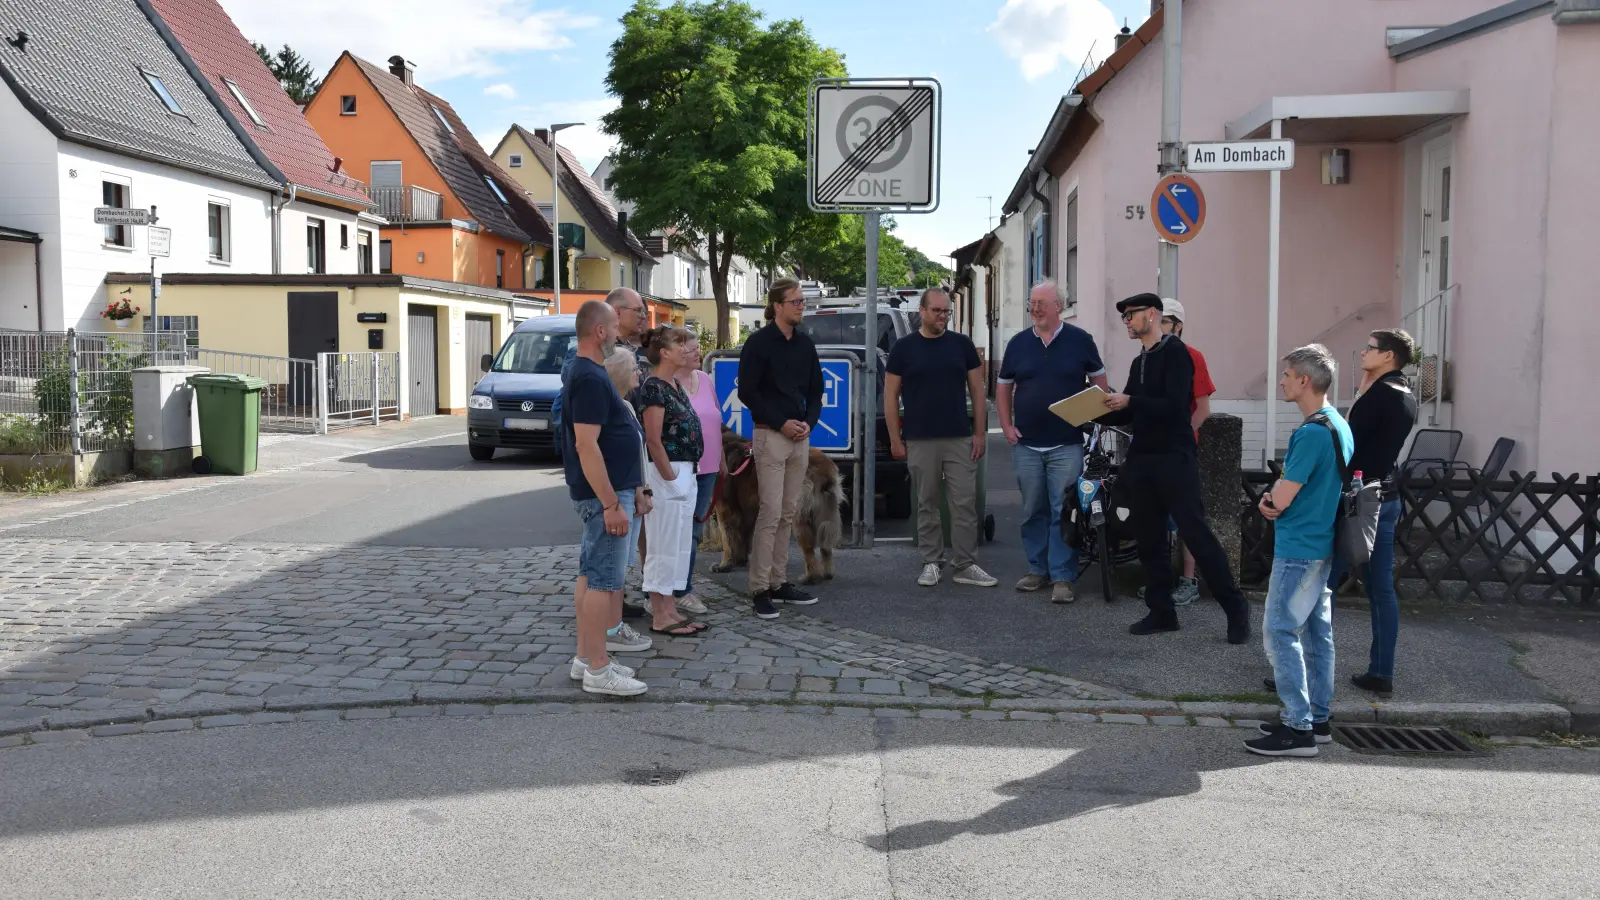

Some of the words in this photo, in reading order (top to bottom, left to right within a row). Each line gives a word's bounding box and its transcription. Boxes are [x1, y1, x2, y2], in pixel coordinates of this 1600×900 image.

[1194, 148, 1216, 163] Am
[1223, 146, 1286, 163] Dombach
[844, 178, 902, 198] ZONE
[1125, 205, 1145, 220] 54
